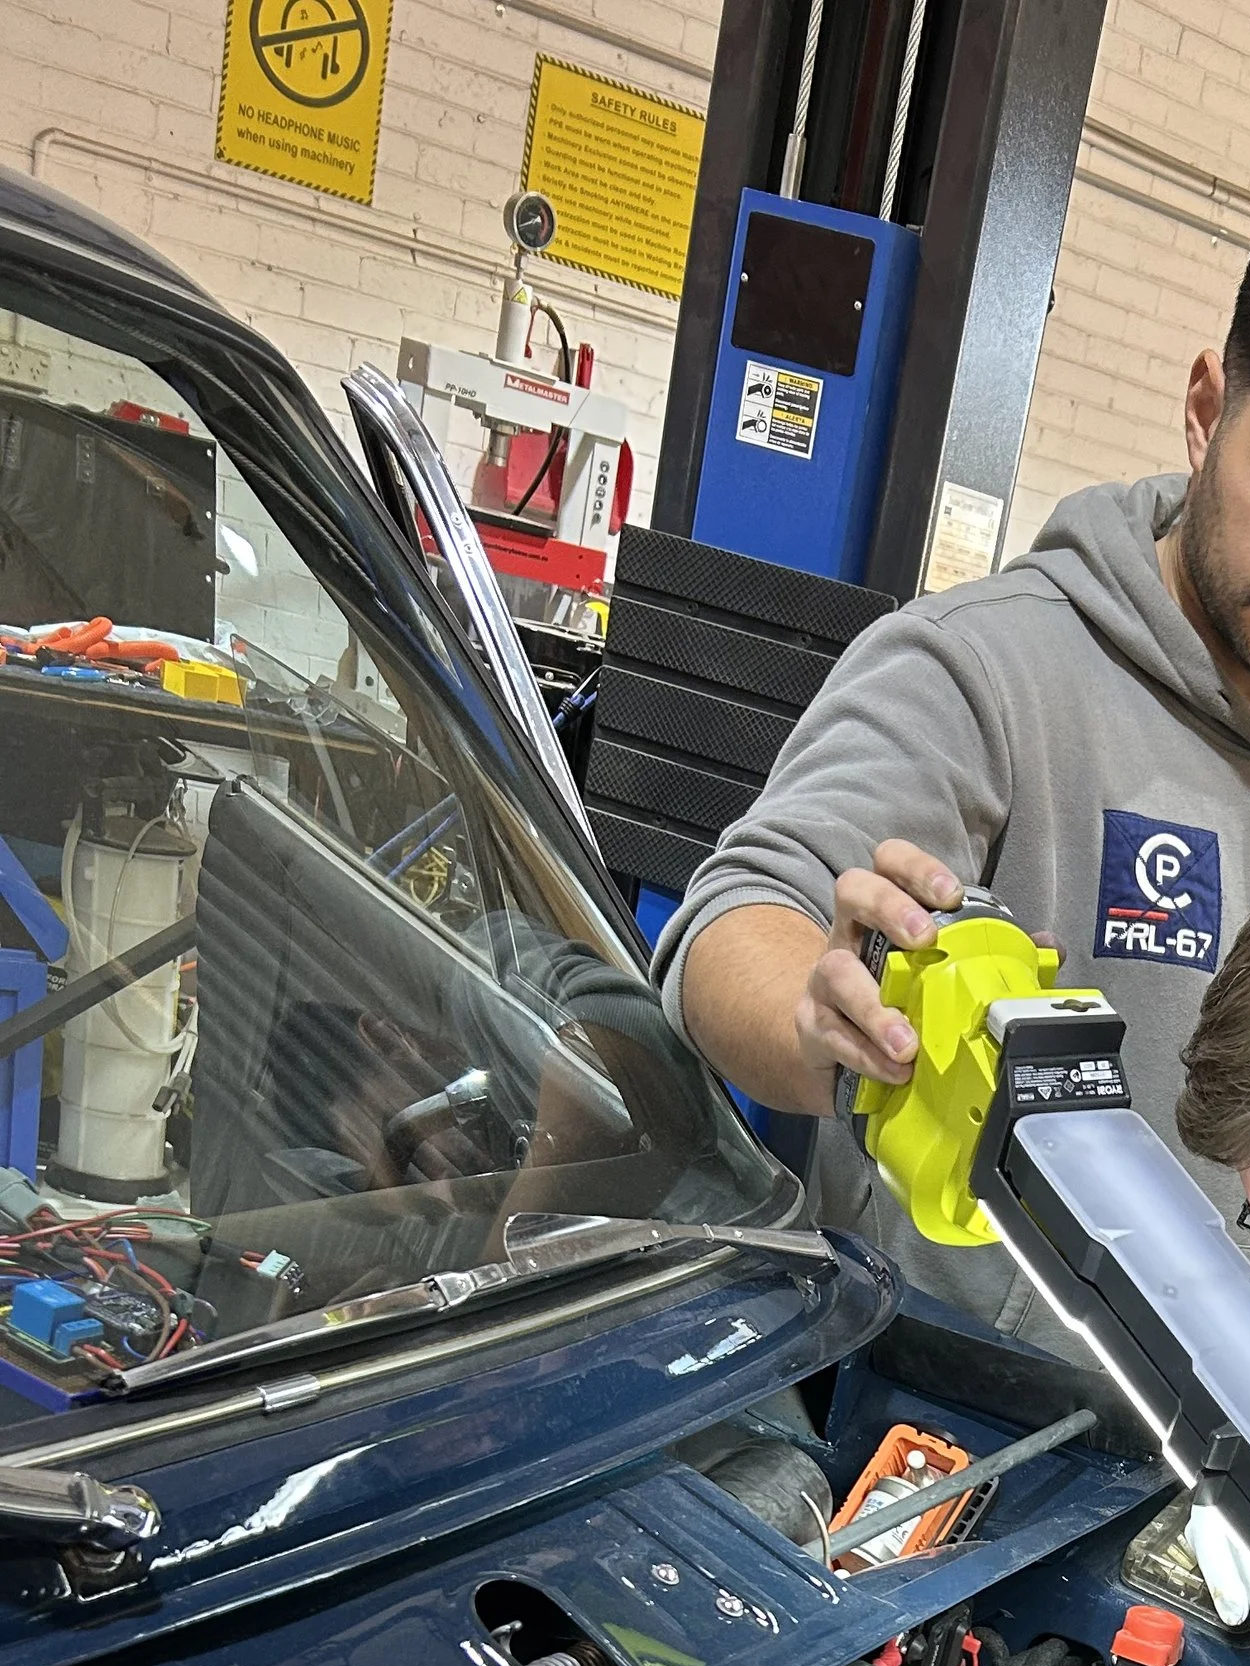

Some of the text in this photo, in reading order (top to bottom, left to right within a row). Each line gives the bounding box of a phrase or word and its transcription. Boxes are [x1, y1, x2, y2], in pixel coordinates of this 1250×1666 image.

[551, 103, 567, 116] Only
[606, 122, 640, 142] personnel
[592, 92, 677, 132] SAFETY RULES
[238, 103, 361, 152] NO HEADPHONE MUSIC
[237, 127, 355, 175] when using machinery
[565, 124, 582, 135] must
[583, 129, 592, 138] be
[613, 138, 630, 152] when
[632, 147, 663, 166] operating
[579, 157, 596, 170] must
[598, 163, 606, 173] be
[639, 165, 656, 177] must
[657, 171, 666, 181] be
[581, 173, 598, 185] must
[600, 179, 608, 188] be
[578, 202, 613, 220] machinery
[592, 221, 608, 232] must
[592, 235, 609, 247] must
[506, 375, 568, 403] METALMASTER
[1104, 920, 1213, 959] PRL-67
[1097, 1083, 1124, 1096] RYOBI
